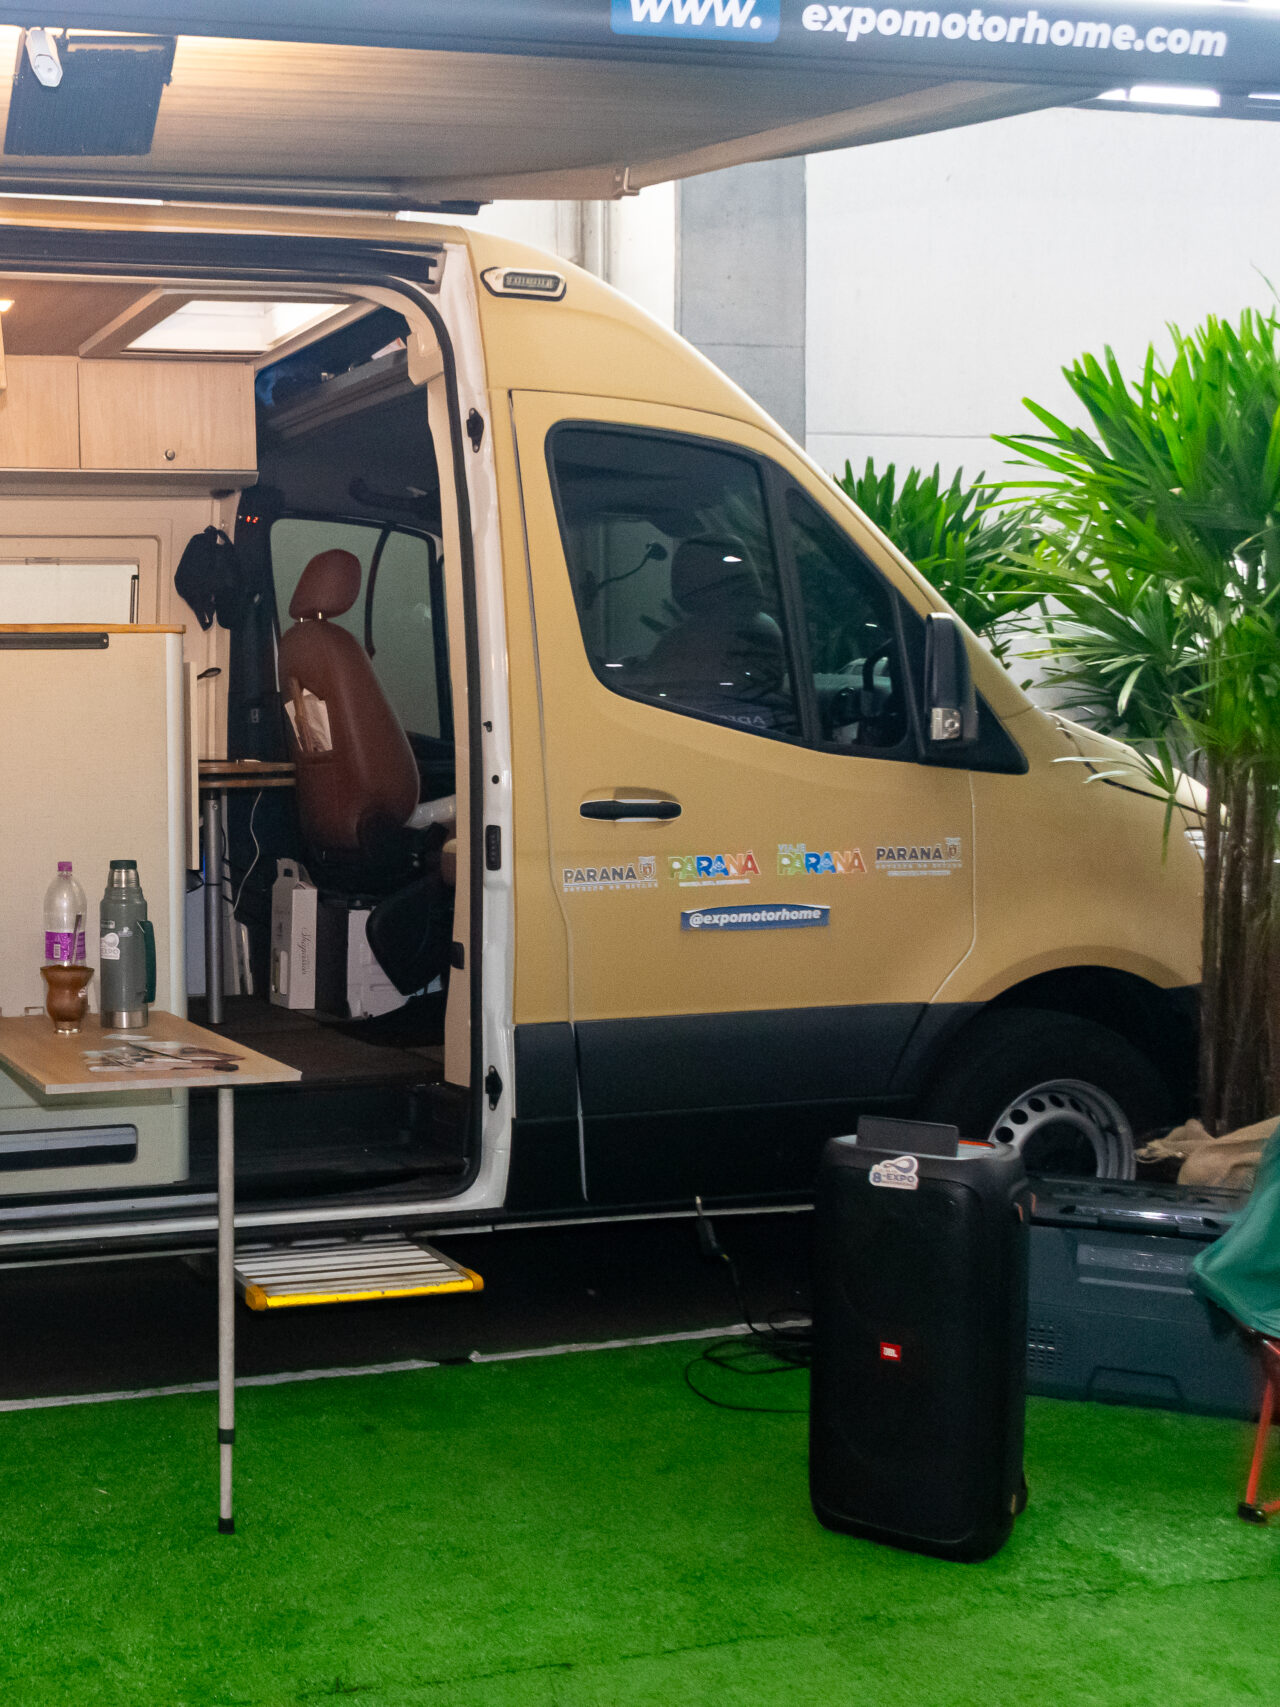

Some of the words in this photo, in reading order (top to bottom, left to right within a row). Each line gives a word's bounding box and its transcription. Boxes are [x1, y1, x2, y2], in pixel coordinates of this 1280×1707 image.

[801, 4, 1228, 57] expomotorhome.com
[667, 849, 761, 880] PARANÁ
[776, 847, 868, 876] PARANÁ
[876, 843, 943, 861] PARANÁ
[563, 863, 638, 884] PARANÁ
[689, 908, 823, 928] @expomotorhome
